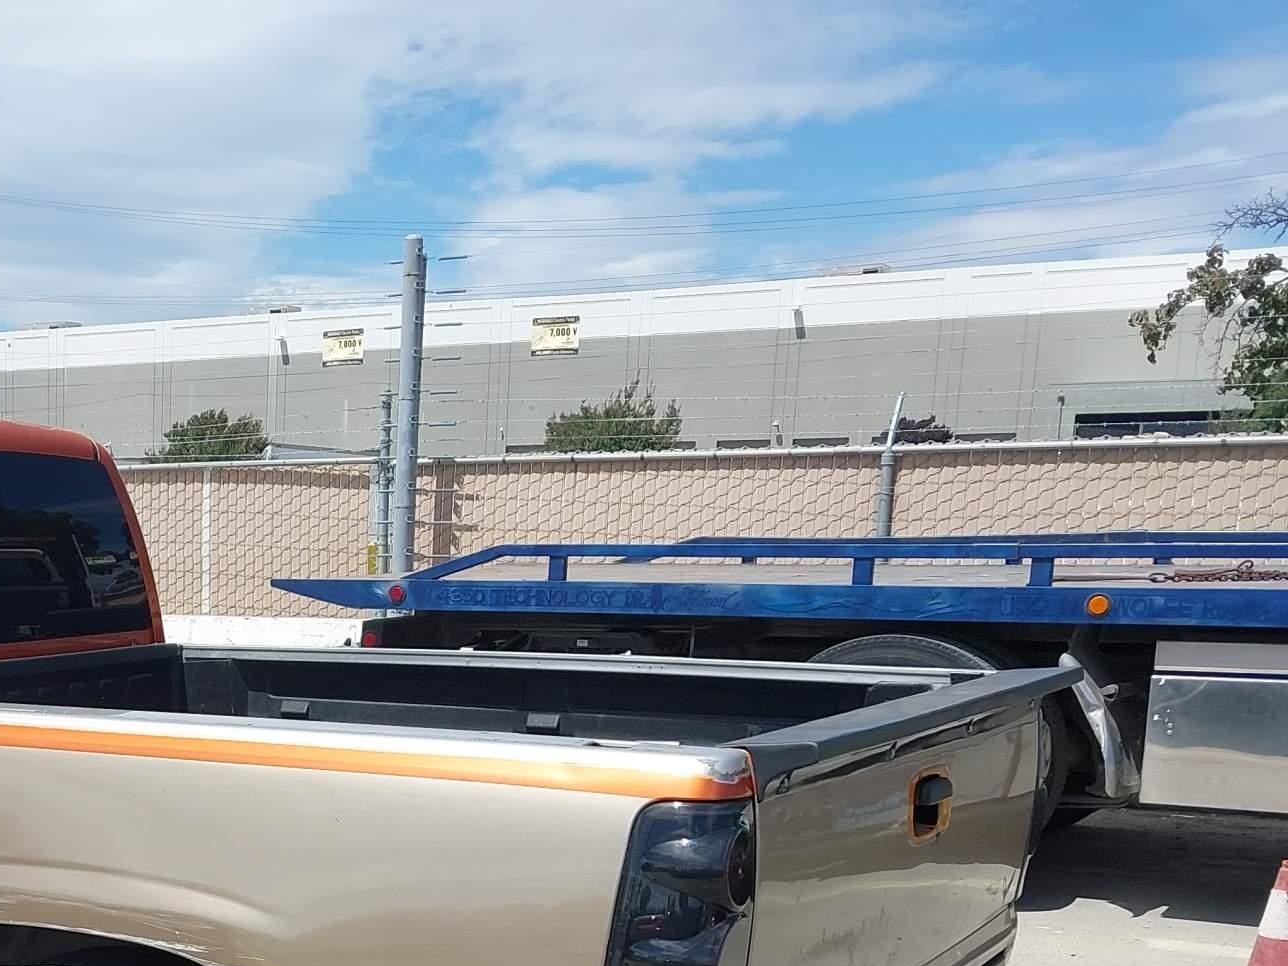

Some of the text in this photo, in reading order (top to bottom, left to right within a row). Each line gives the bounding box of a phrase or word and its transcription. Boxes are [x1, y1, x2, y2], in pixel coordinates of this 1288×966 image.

[548, 327, 578, 337] 7,000 V
[338, 340, 356, 350] 7,000
